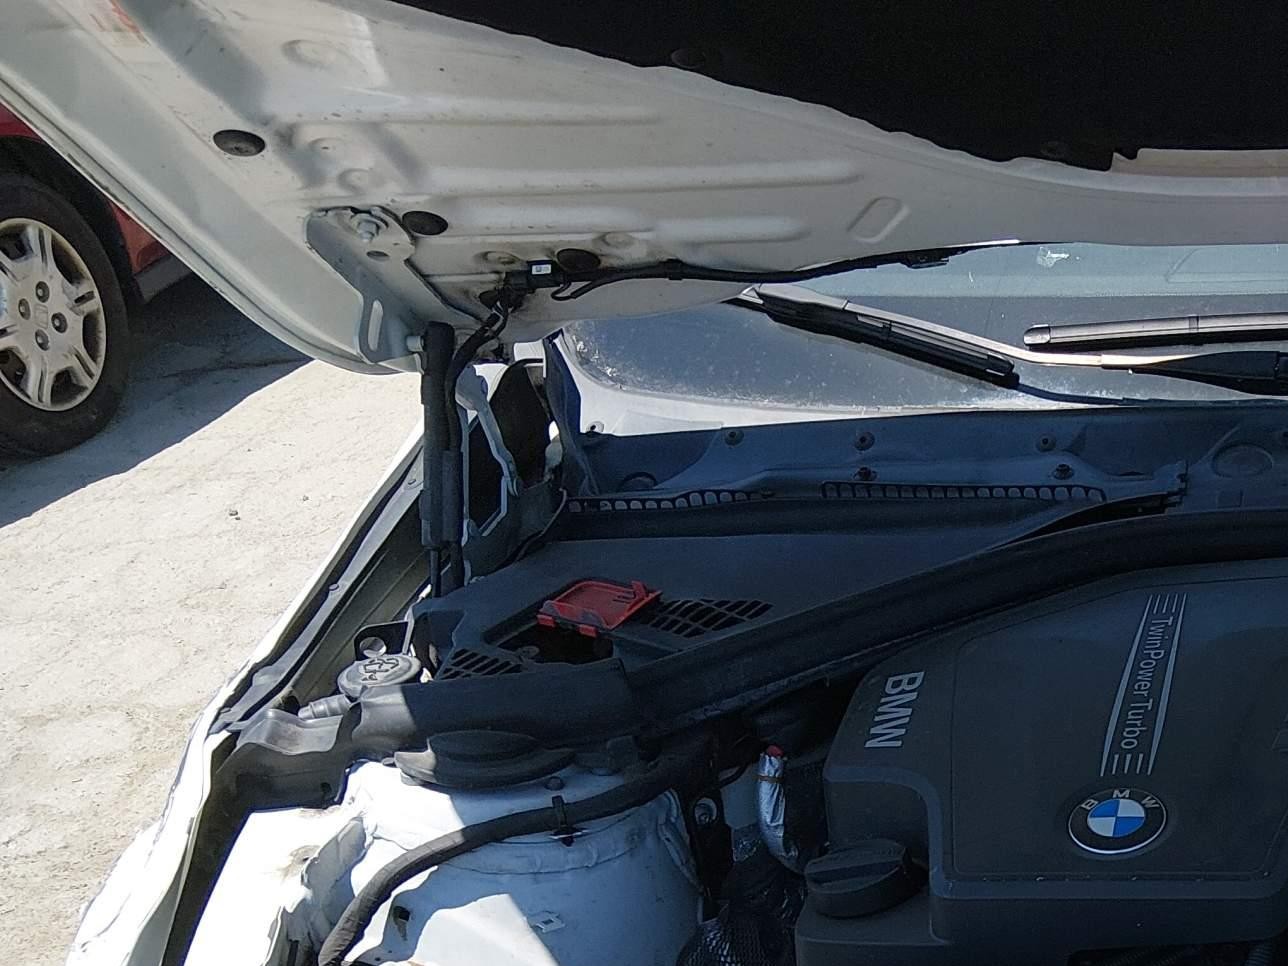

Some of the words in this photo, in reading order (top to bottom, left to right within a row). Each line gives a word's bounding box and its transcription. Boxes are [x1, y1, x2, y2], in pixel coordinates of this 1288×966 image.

[1133, 616, 1174, 697] TwinPower
[864, 671, 925, 748] BMW
[1120, 699, 1154, 749] Turbo
[1080, 789, 1160, 811] BMW
